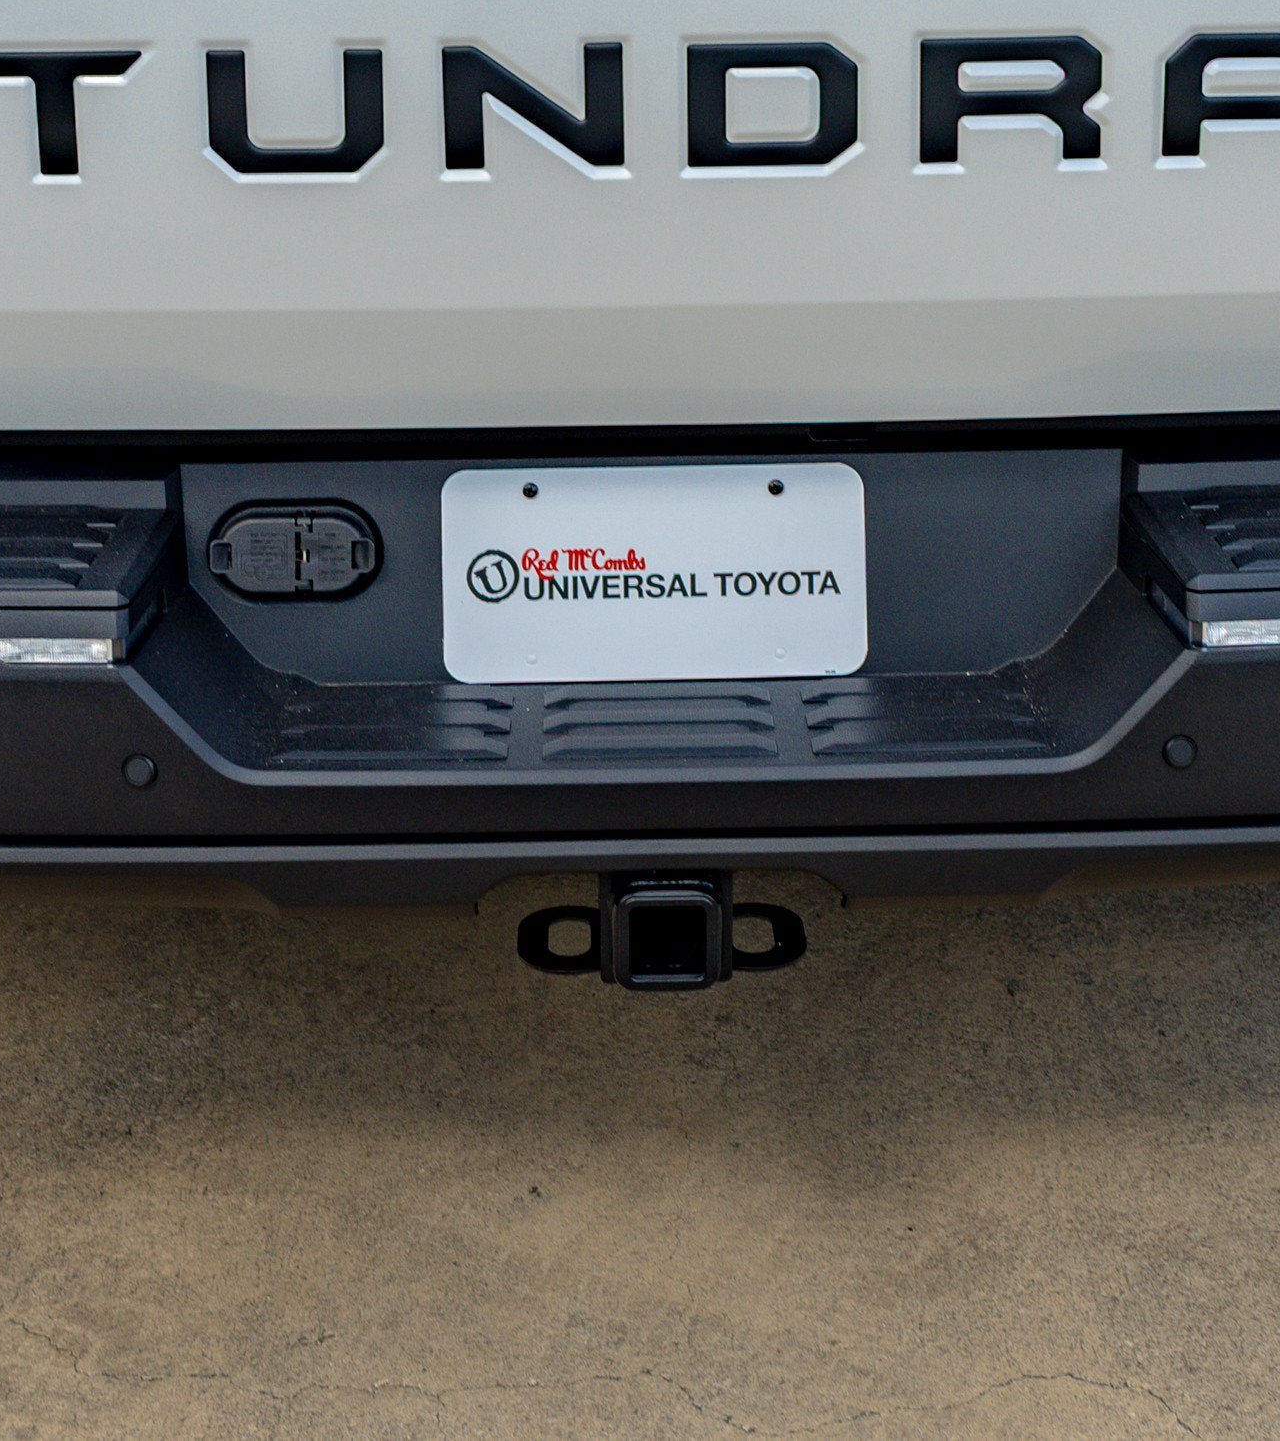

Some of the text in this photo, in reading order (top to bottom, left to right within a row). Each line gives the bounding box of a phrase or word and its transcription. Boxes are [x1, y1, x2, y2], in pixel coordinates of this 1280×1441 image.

[521, 547, 646, 580] Red McCombs
[523, 569, 842, 600] UNIVERSAL TOYOTA
